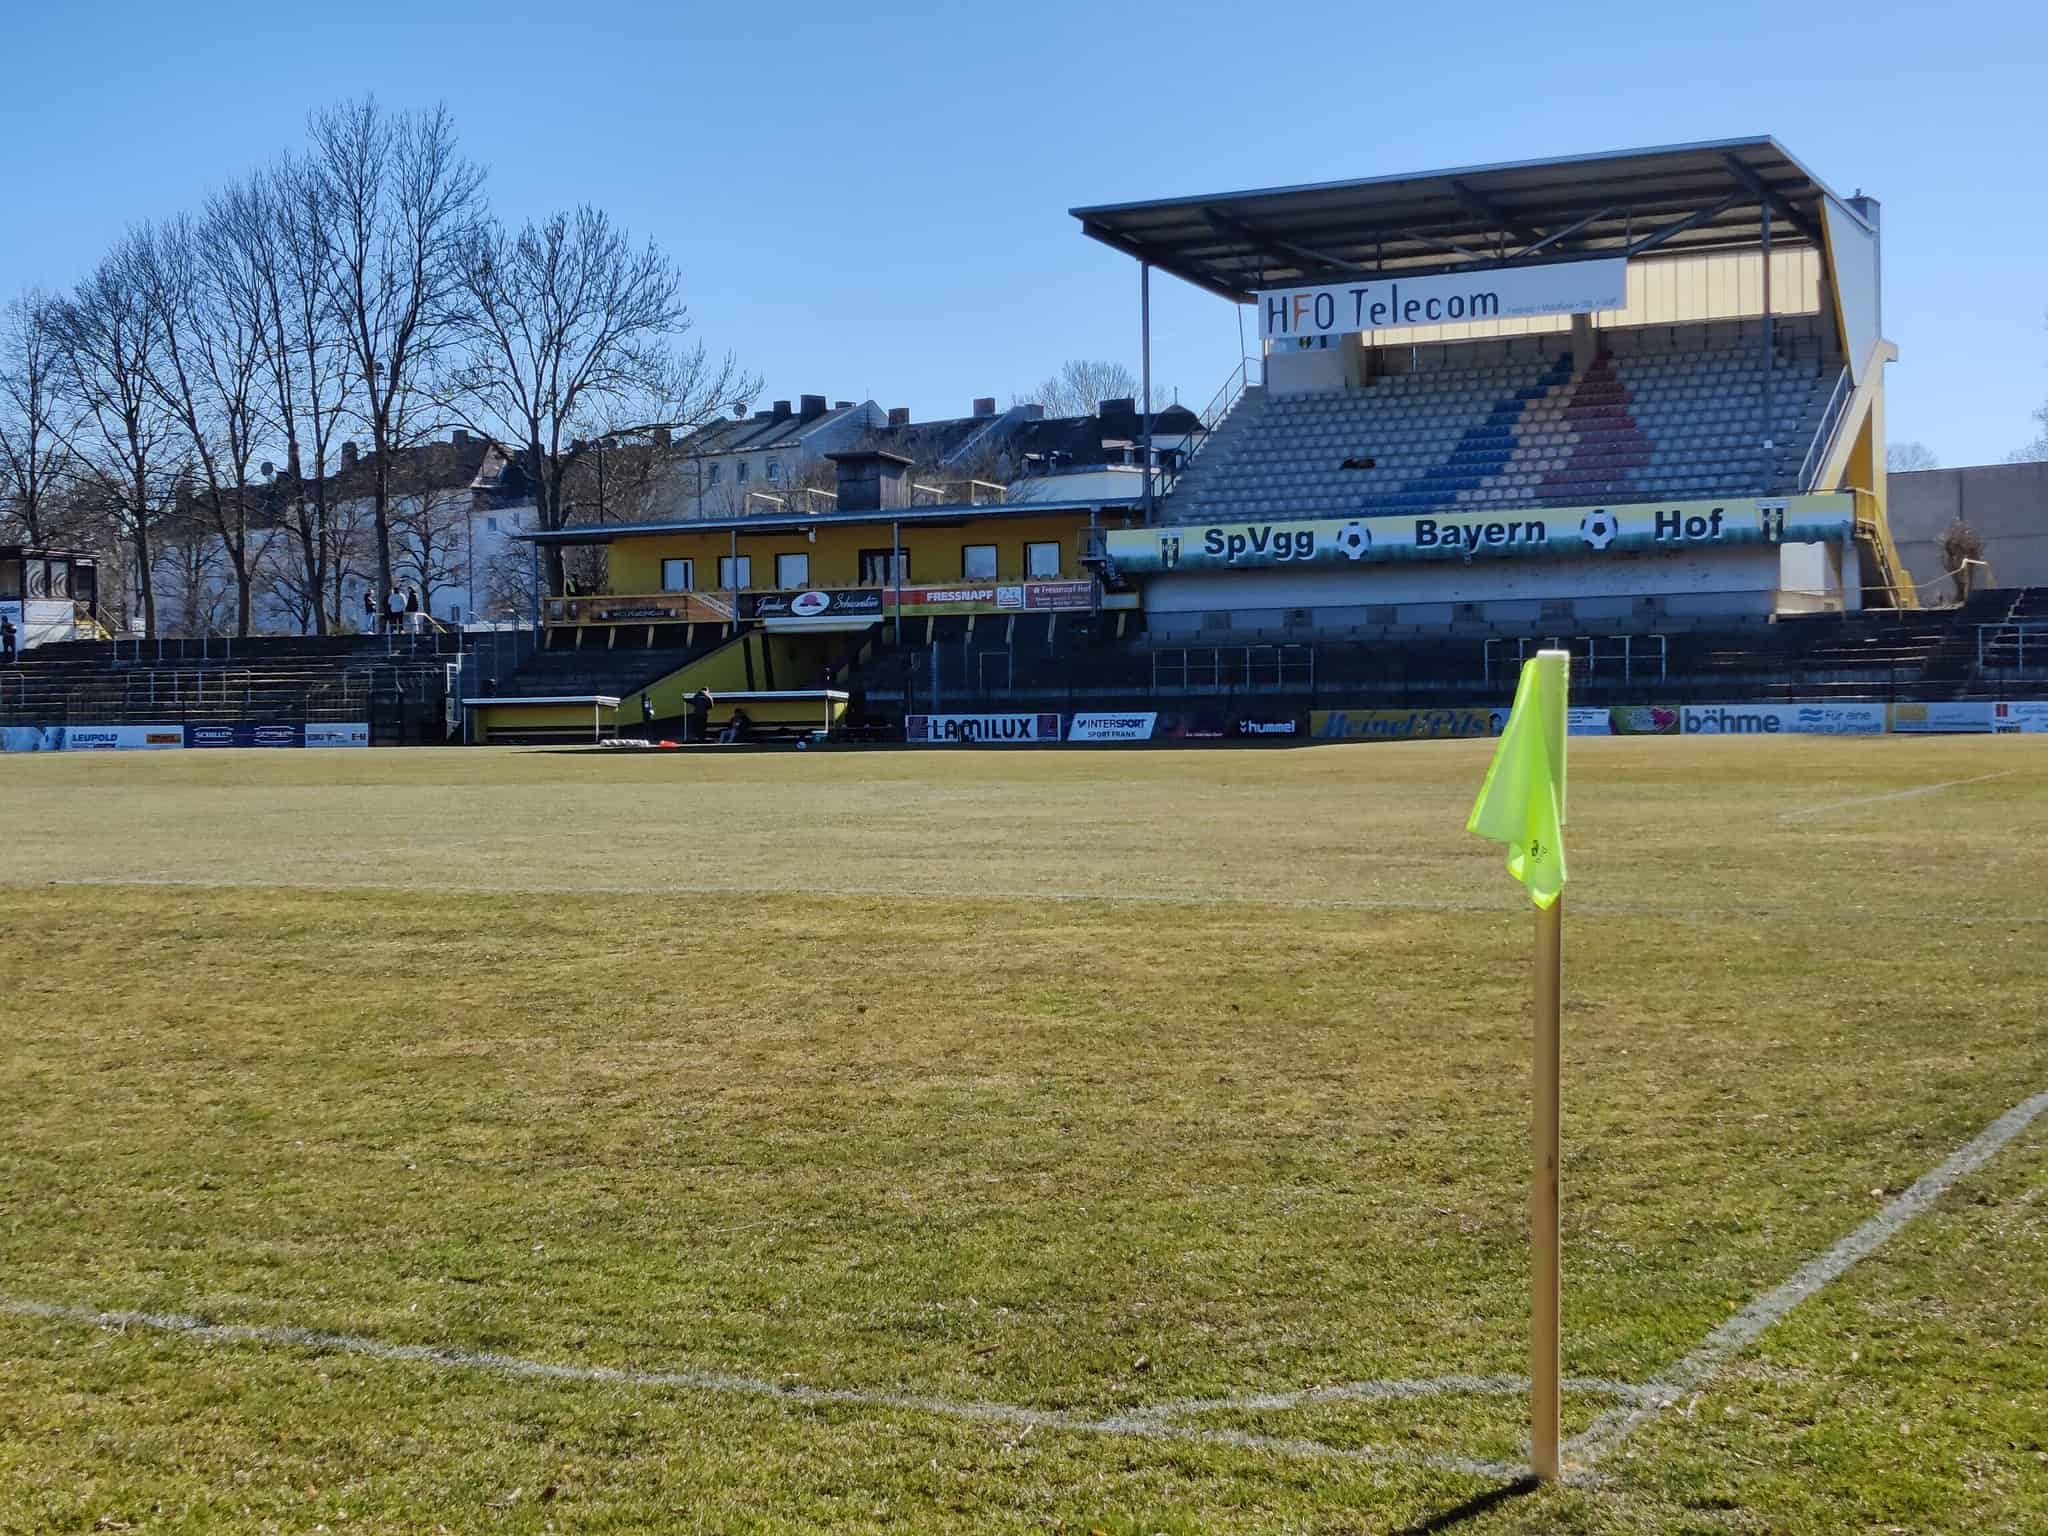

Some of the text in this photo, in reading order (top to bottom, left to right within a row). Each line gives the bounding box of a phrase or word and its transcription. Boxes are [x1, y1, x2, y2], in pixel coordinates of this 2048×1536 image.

[1267, 292, 1335, 334] HFO
[1350, 283, 1499, 327] Telecom
[1203, 508, 1725, 561] SpVgg Bayern Hof
[926, 590, 993, 602] FRESSNAPF
[1087, 718, 1147, 729] INTERSPORT
[1248, 719, 1296, 734] hummel
[1684, 708, 1781, 734] böhme
[71, 733, 118, 742] LEUPOLD
